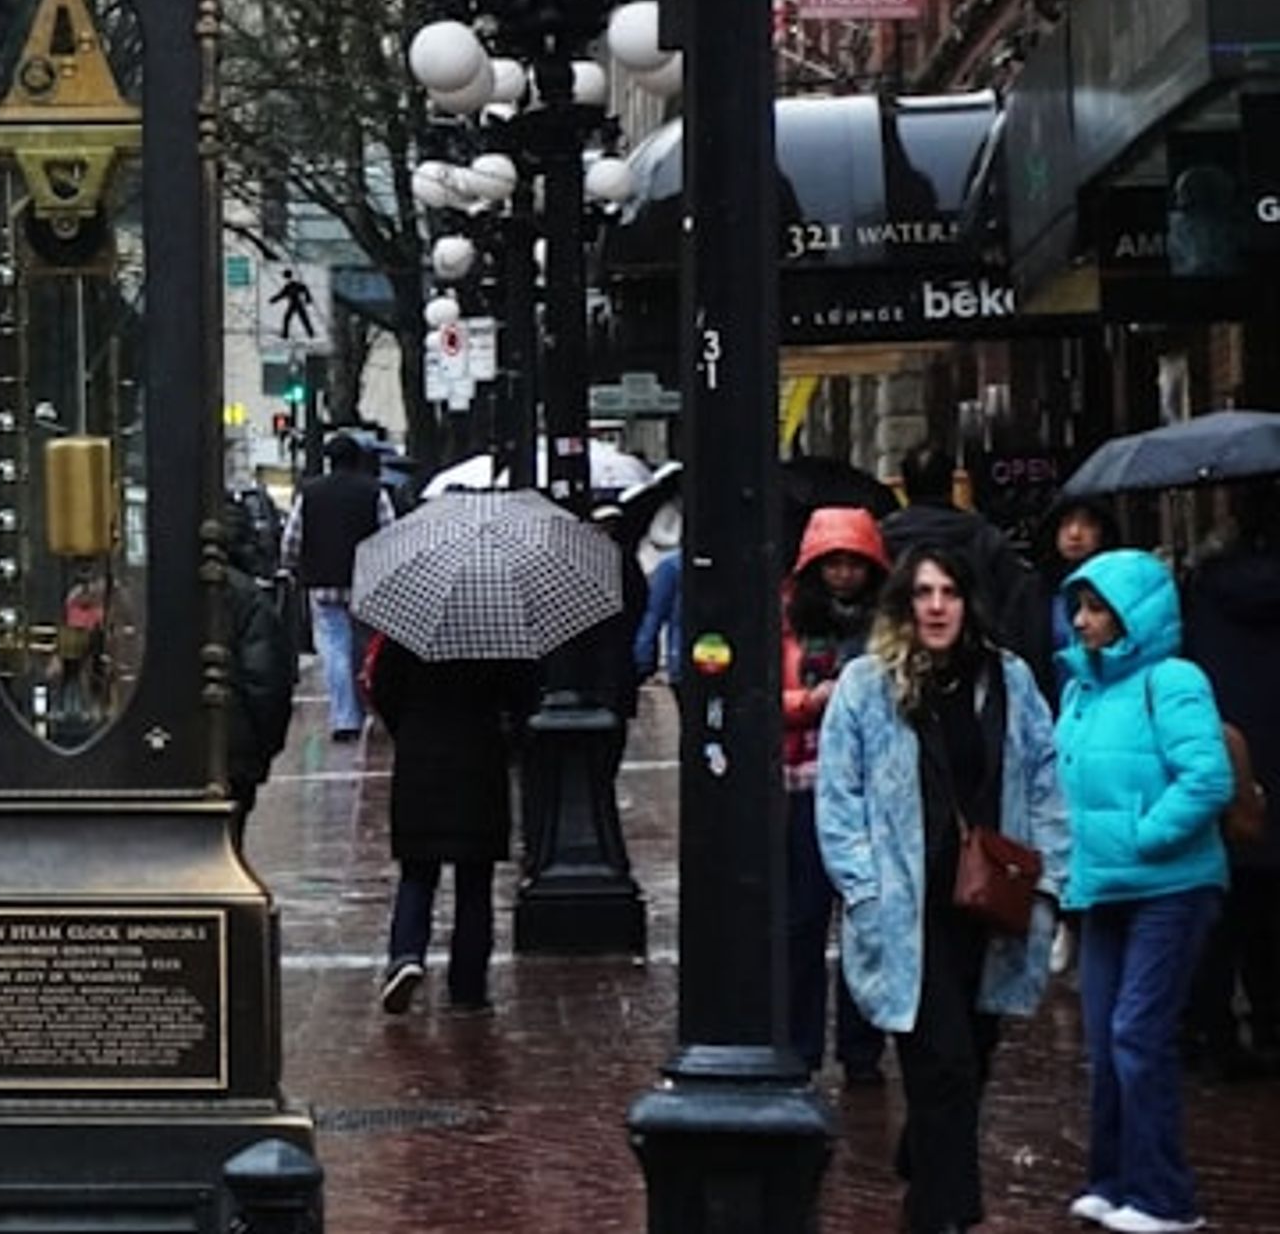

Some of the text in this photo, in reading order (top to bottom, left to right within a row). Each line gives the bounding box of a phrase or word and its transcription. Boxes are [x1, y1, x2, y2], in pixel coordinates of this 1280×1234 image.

[788, 224, 842, 259] 321
[856, 222, 949, 245] WATER
[10, 924, 62, 941] STEAM
[67, 924, 119, 941] CLOCK
